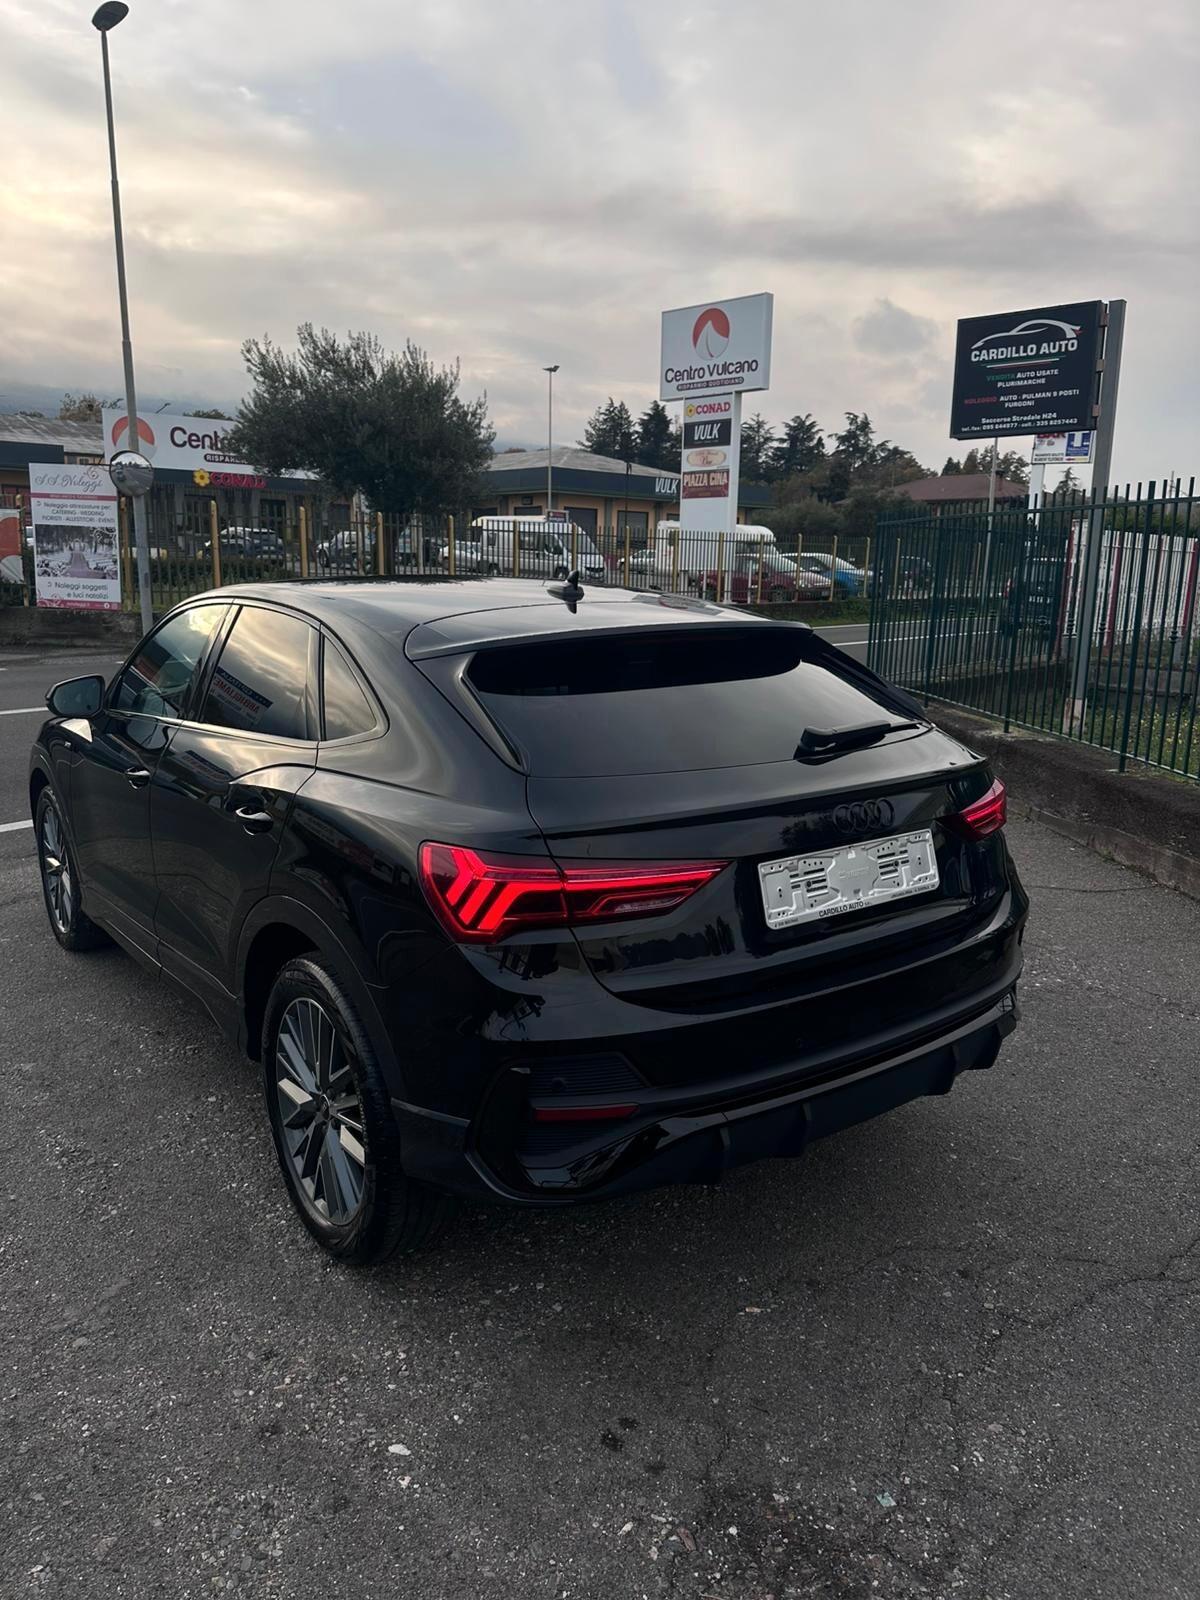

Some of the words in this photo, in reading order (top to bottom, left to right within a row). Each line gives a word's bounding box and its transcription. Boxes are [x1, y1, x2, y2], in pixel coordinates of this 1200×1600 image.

[970, 344, 1037, 362] CARDILLO
[1040, 340, 1078, 354] AUTO
[665, 366, 705, 383] Centro
[707, 360, 759, 376] Vulcano
[708, 378, 744, 387] QUOTIDIANO
[997, 378, 1046, 388] PLURIMARCHE
[1022, 391, 1051, 399] PULMAN
[696, 402, 731, 415] CONAD
[1004, 400, 1035, 408] FURGONI
[1012, 414, 1041, 422] Stradale
[170, 426, 221, 450] Cent
[694, 423, 721, 440] VULK
[210, 472, 266, 488] CONAD
[655, 477, 679, 494] VULK
[683, 473, 708, 487] PIAZZA
[54, 582, 81, 590] Noleggi
[82, 583, 108, 591] soggetti
[818, 905, 848, 917] CARDILLO
[848, 901, 864, 911] AUTO
